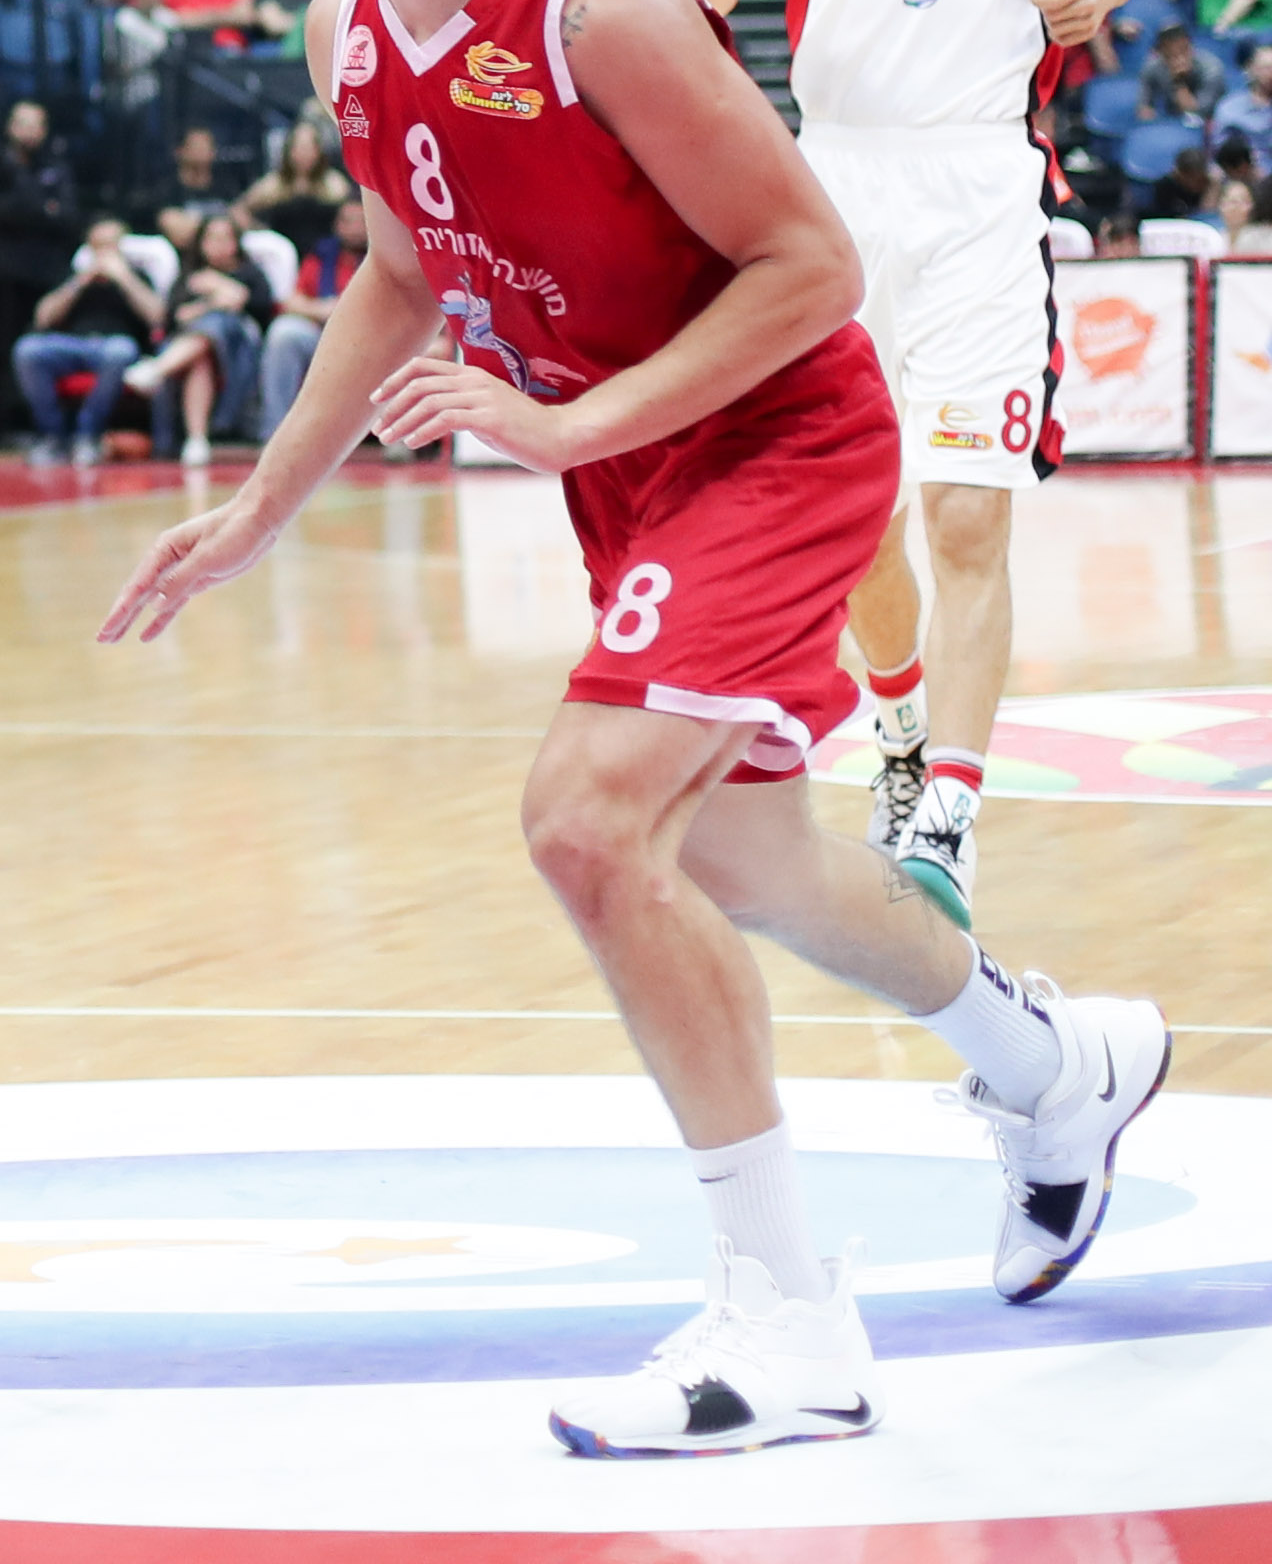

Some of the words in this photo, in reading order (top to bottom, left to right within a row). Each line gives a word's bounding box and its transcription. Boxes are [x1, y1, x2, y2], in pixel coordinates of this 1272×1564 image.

[459, 88, 514, 111] Winner
[405, 122, 455, 221] 8
[493, 258, 567, 317] מועצה
[1001, 389, 1032, 455] 8
[601, 562, 673, 654] 8
